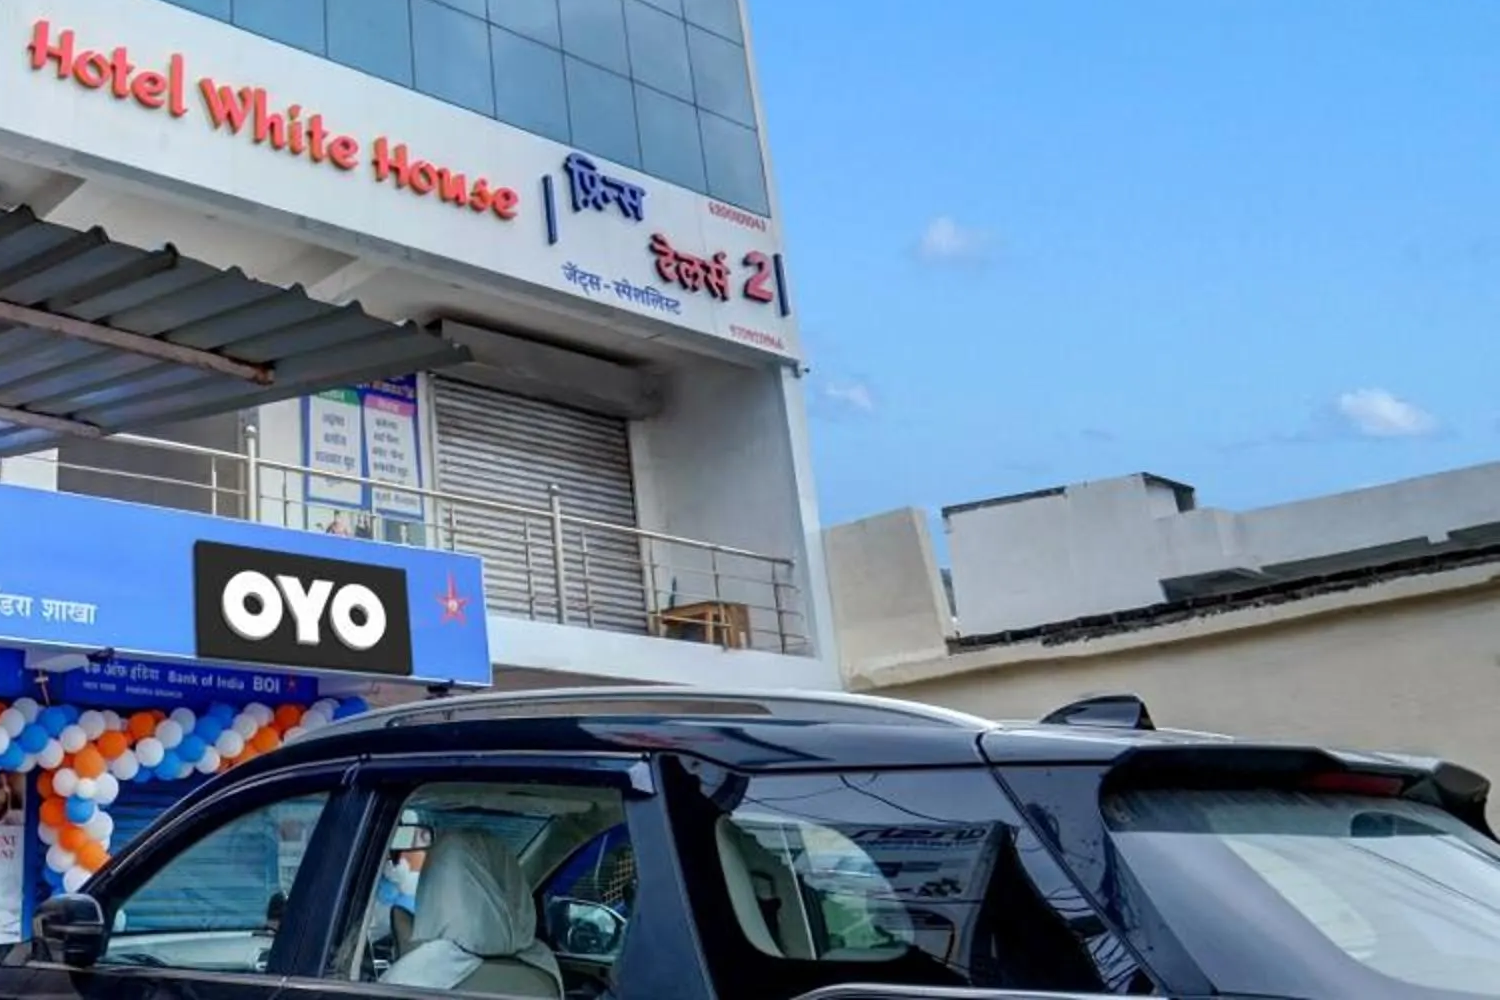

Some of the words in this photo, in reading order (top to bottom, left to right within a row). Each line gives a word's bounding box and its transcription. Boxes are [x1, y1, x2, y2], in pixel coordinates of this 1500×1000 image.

[27, 20, 188, 117] Hotel
[199, 77, 359, 170] White
[372, 136, 520, 219] House
[742, 251, 774, 303] 2
[41, 599, 99, 625] शाखा
[221, 570, 387, 650] OYO
[167, 669, 199, 686] Bank
[201, 673, 213, 687] of
[216, 675, 245, 691] India
[253, 676, 281, 694] BOI
